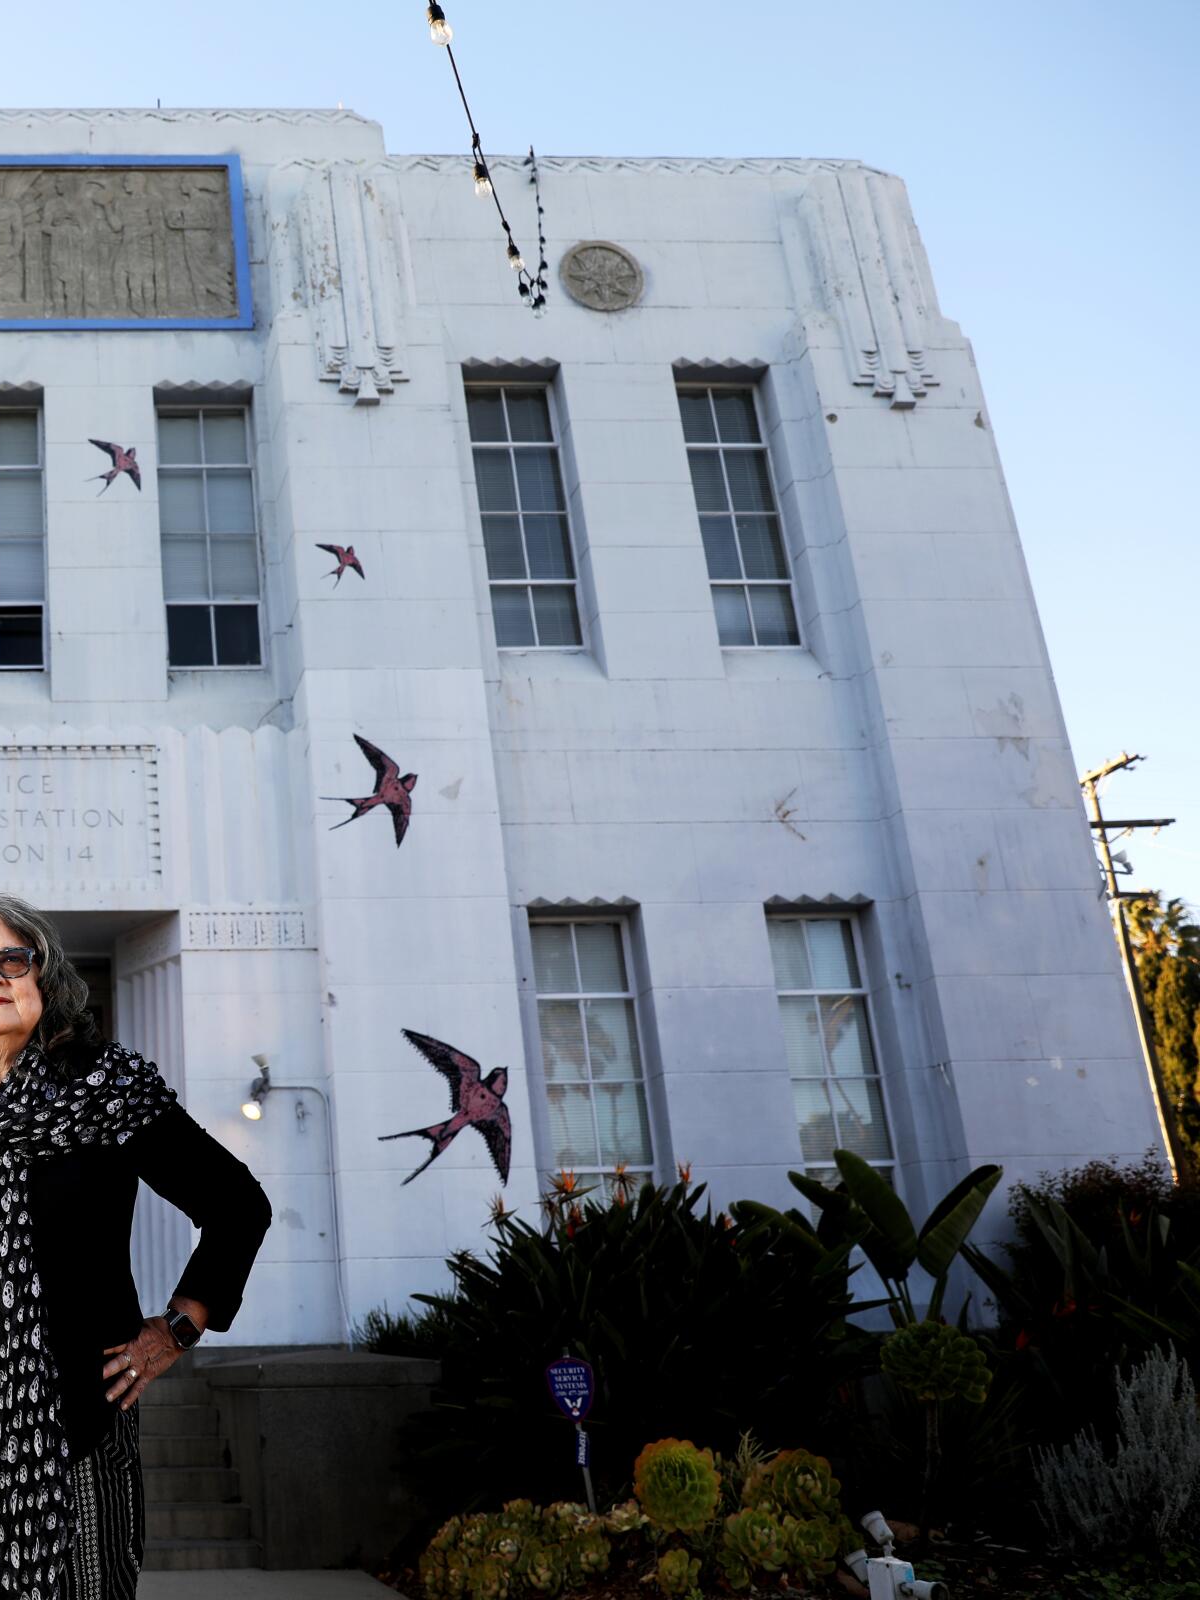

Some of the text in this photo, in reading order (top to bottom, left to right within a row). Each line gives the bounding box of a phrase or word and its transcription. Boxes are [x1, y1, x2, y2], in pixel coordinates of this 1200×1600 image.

[0, 808, 125, 828] STATION
[66, 845, 95, 862] 14
[554, 1374, 585, 1382] SERVICE
[555, 1382, 587, 1390] SYSTEMS
